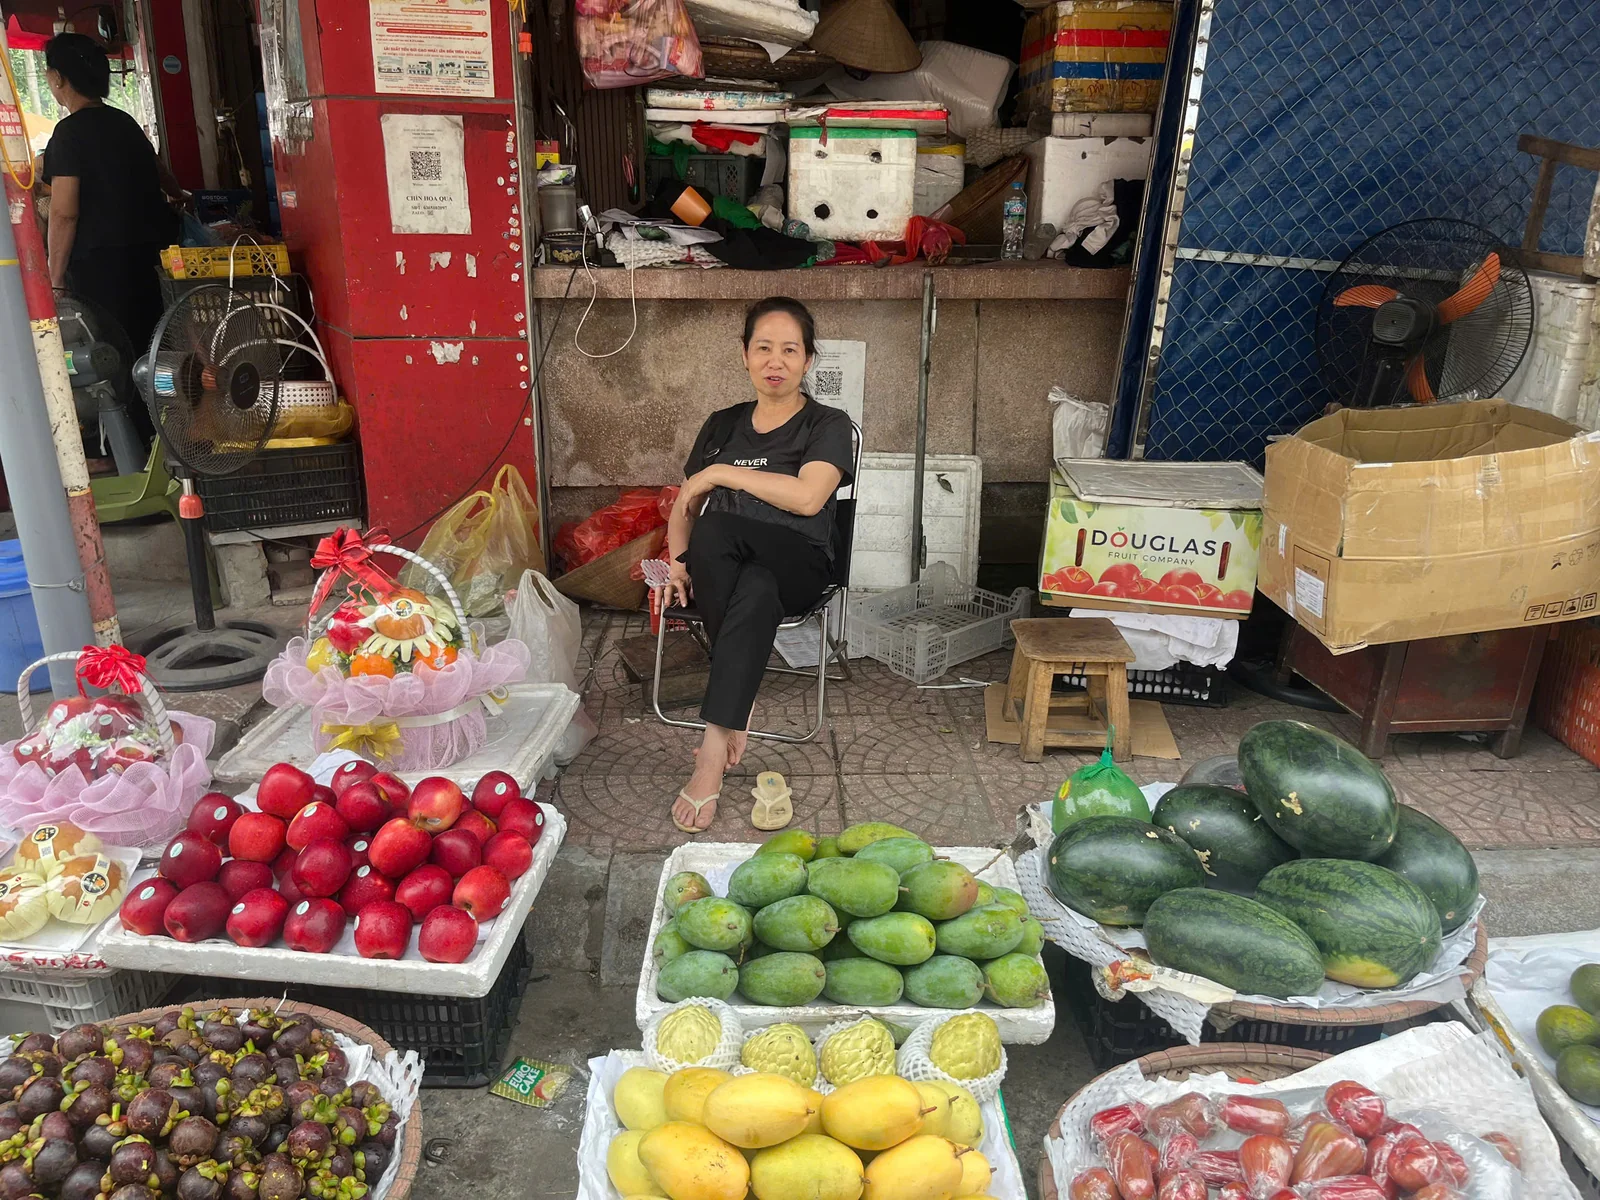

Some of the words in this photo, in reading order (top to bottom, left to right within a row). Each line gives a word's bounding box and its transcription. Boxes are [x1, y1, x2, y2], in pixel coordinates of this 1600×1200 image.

[734, 457, 768, 466] NEVER
[1091, 527, 1217, 557] DOUGLAS
[1108, 551, 1138, 561] FRUIT
[1142, 554, 1195, 566] COMPANY
[509, 1064, 531, 1089] EURO
[519, 1068, 541, 1094] CAKE
